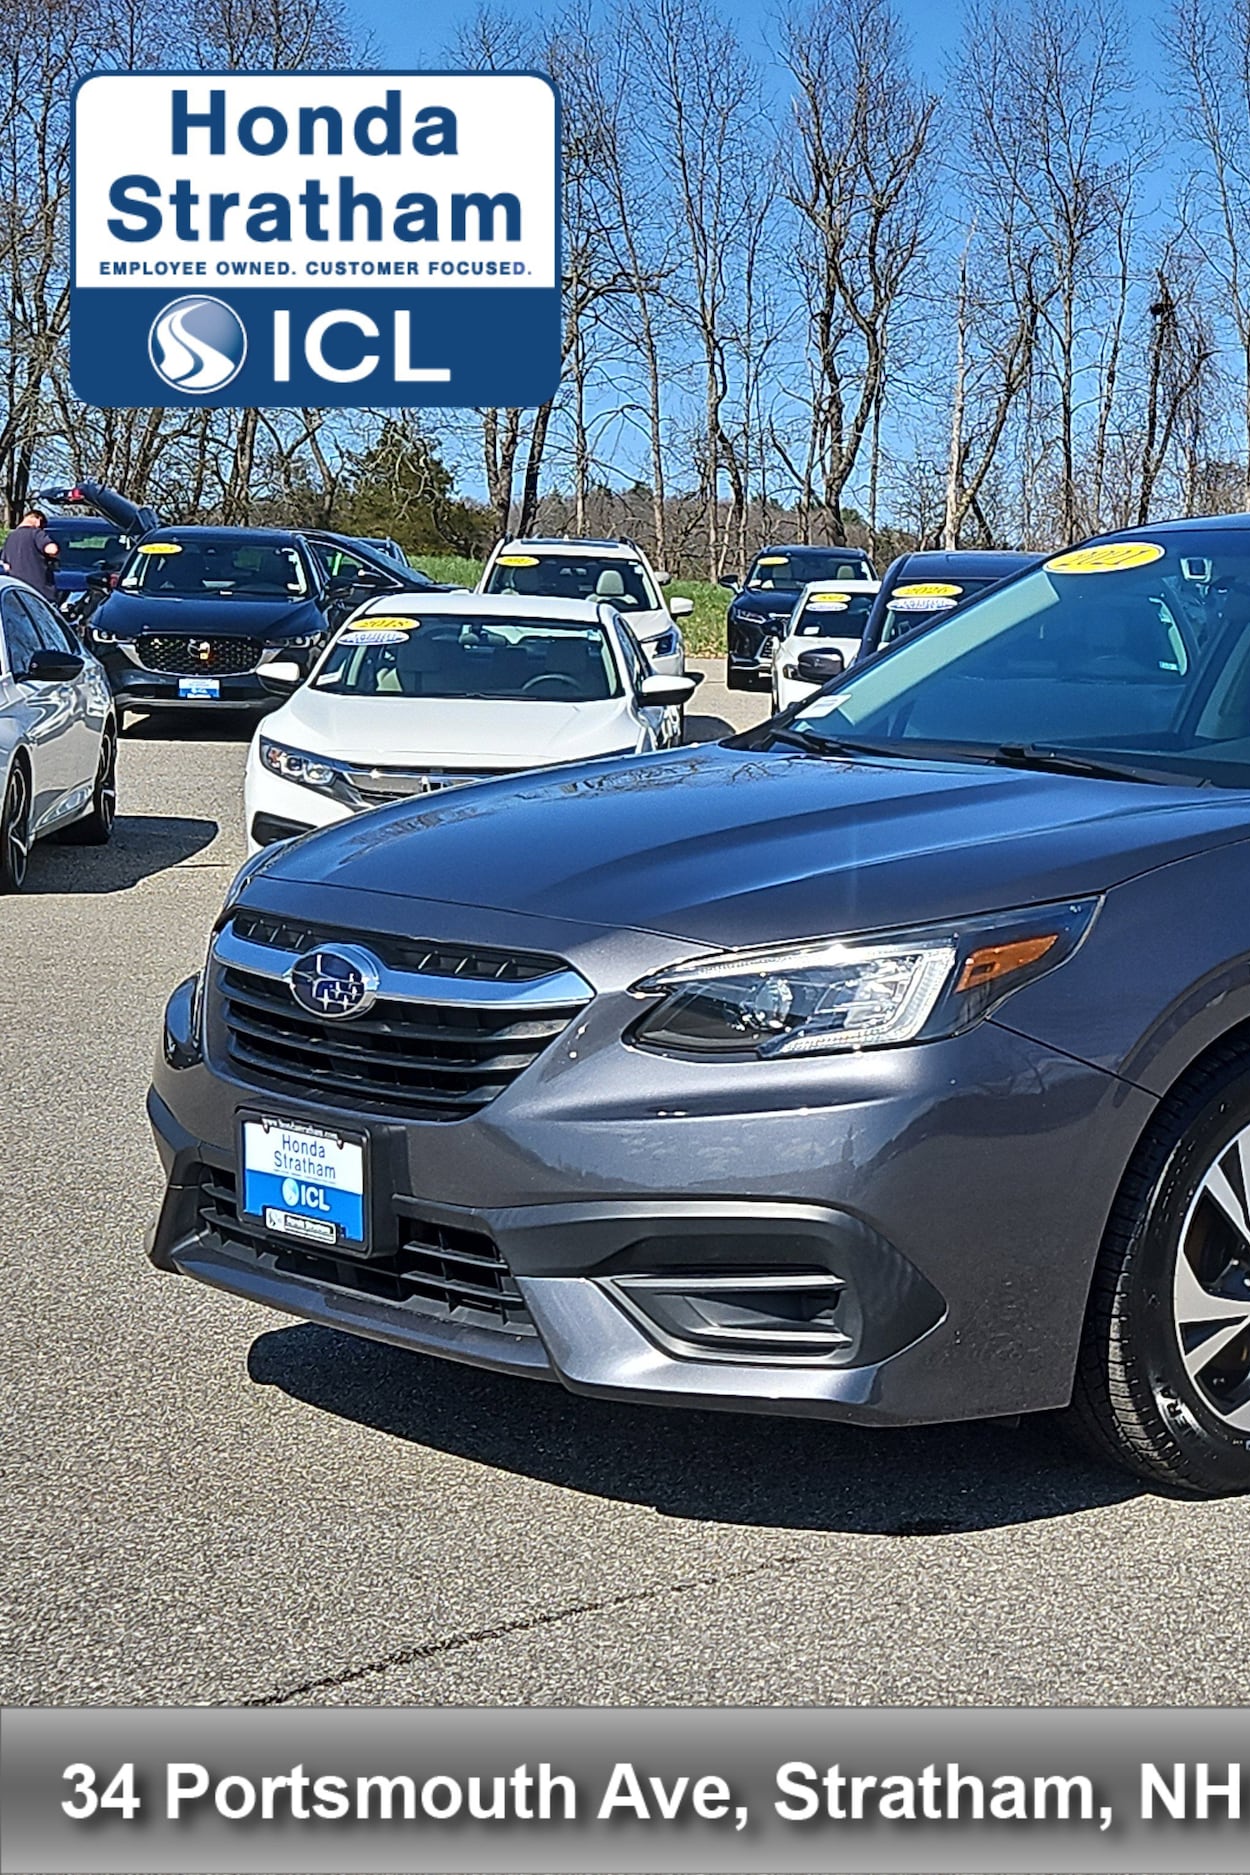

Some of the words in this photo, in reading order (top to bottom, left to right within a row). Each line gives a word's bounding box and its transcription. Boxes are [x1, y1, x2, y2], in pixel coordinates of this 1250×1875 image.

[282, 1133, 326, 1159] Honda
[273, 1149, 336, 1180] Stratham
[300, 1184, 331, 1212] ICL
